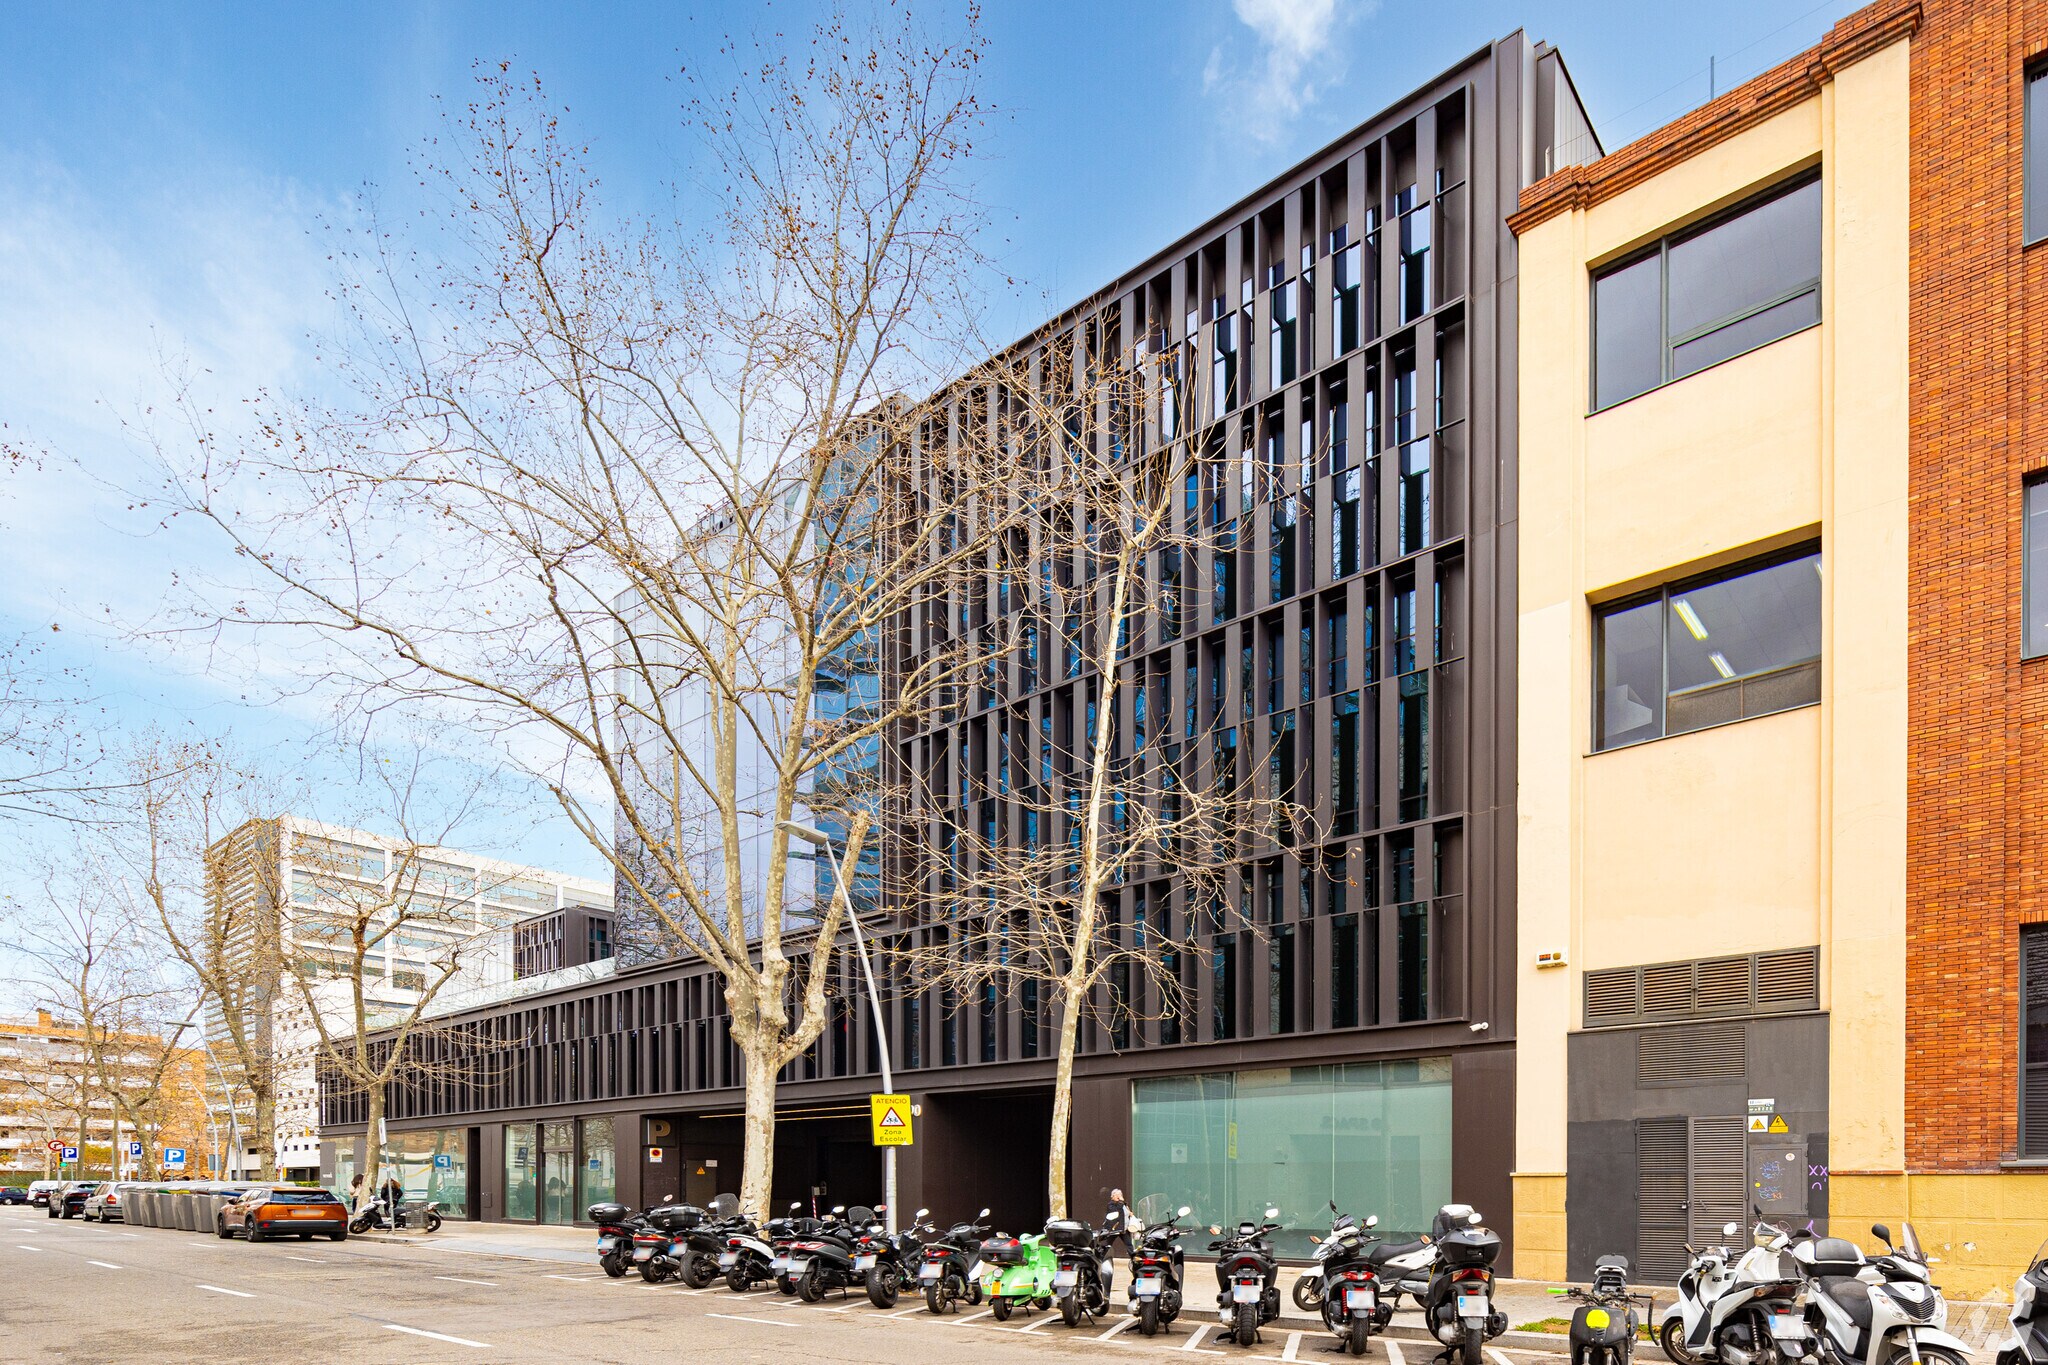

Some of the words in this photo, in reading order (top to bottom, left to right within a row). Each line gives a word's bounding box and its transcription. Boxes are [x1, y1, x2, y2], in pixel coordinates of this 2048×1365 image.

[647, 1119, 671, 1145] P
[65, 1148, 75, 1158] P
[132, 1143, 140, 1154] P
[168, 1150, 181, 1161] P
